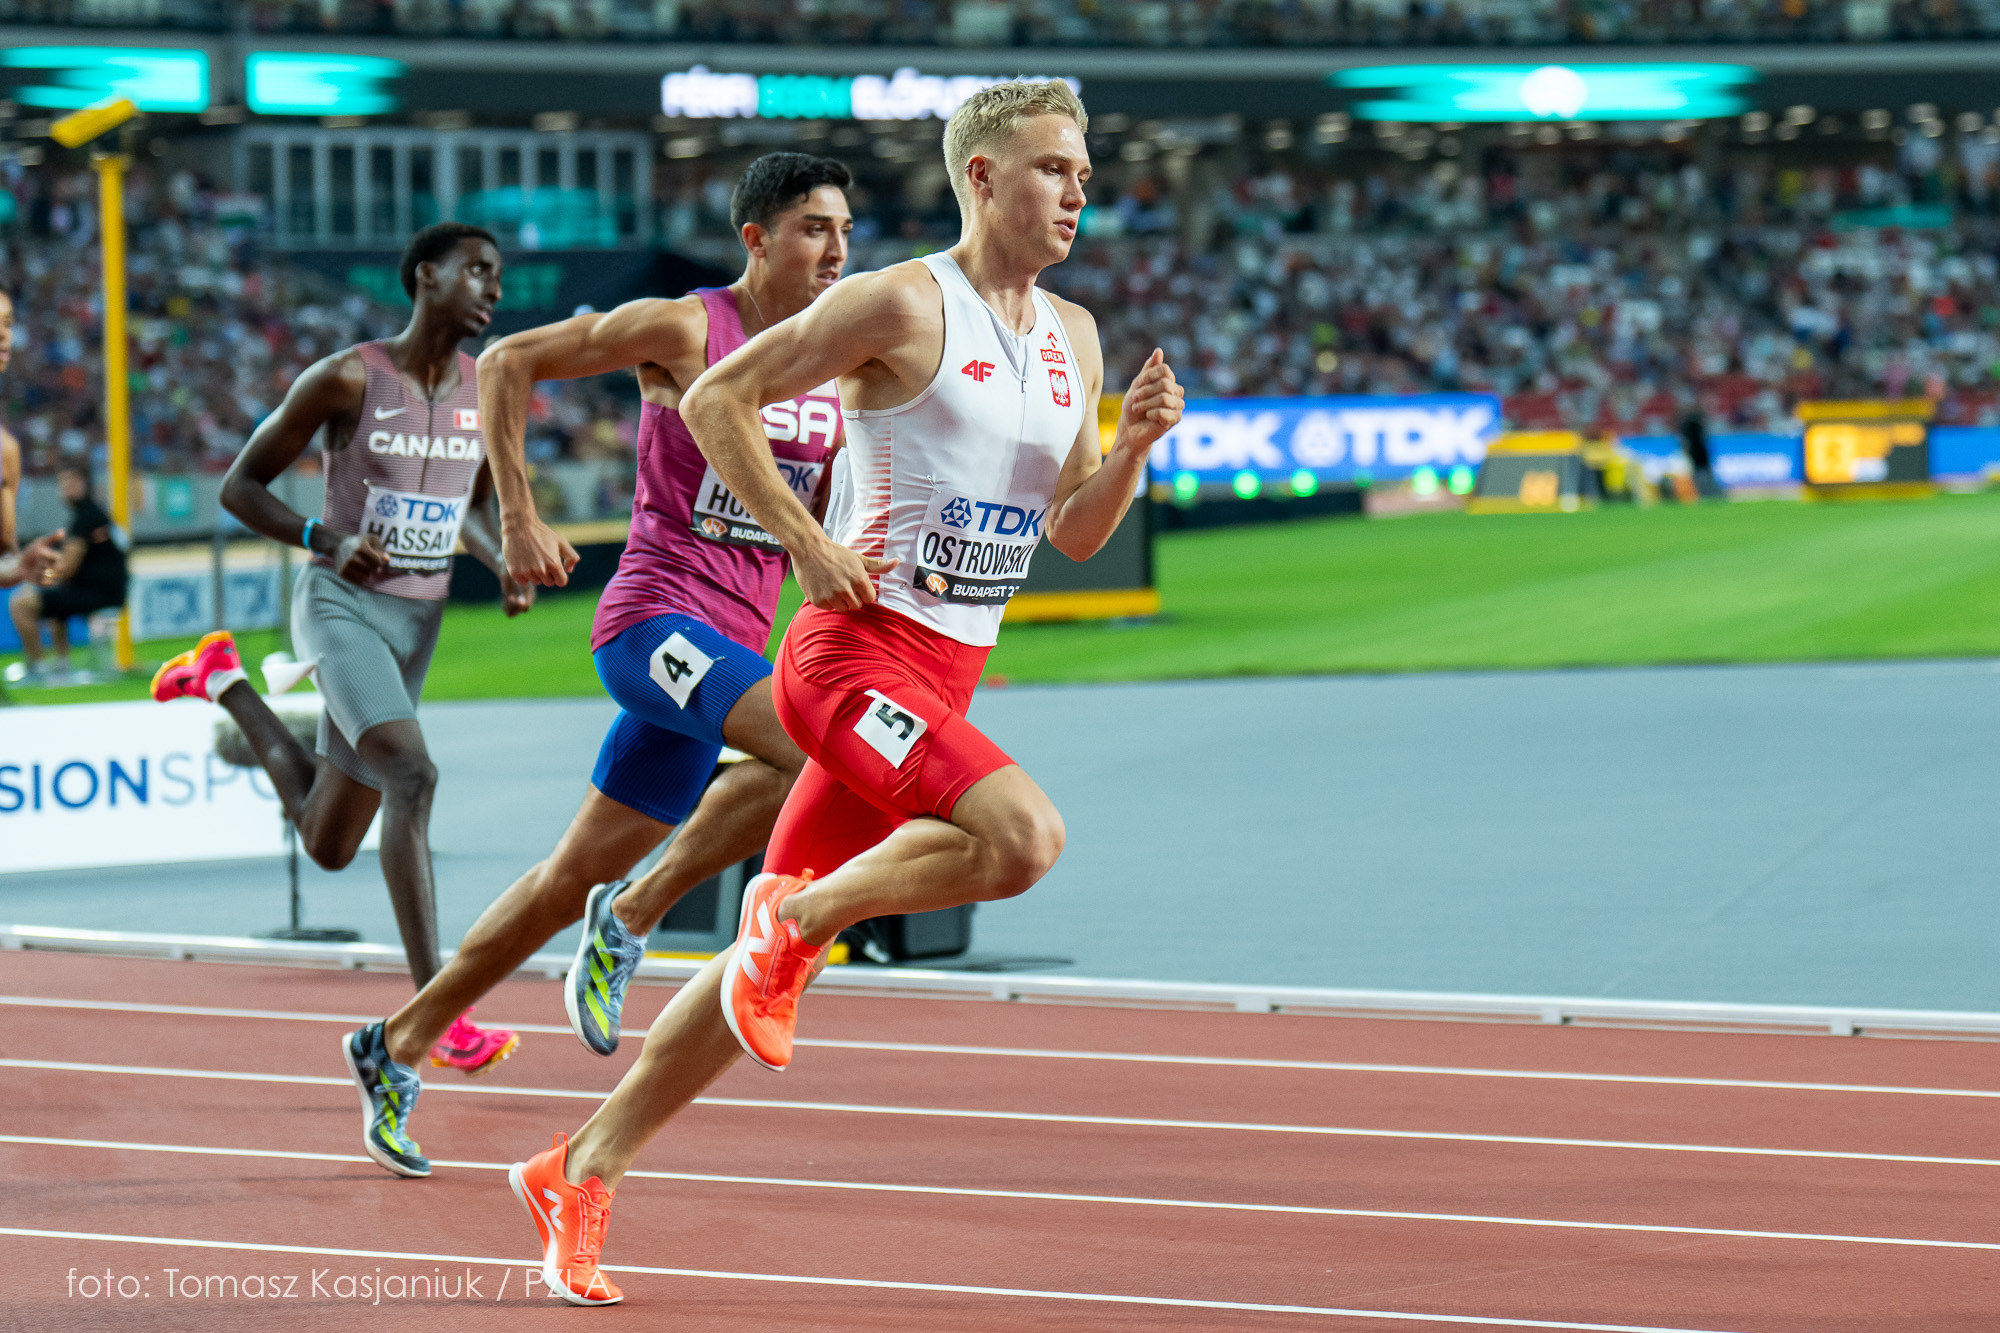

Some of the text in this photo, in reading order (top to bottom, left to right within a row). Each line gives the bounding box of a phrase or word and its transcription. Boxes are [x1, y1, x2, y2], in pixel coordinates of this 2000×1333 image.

[961, 359, 995, 382] 4F
[759, 399, 837, 448] SA
[1340, 405, 1492, 467] TDK
[368, 430, 480, 461] CANADA
[777, 463, 815, 493] DK
[401, 498, 461, 523] TDK
[975, 500, 1047, 537] TDK
[730, 526, 780, 546] BUDAPES
[922, 531, 1035, 576] OSTROWSKI
[952, 583, 1007, 598] BUDAPEST
[661, 650, 694, 684] 4
[875, 702, 915, 741] 5
